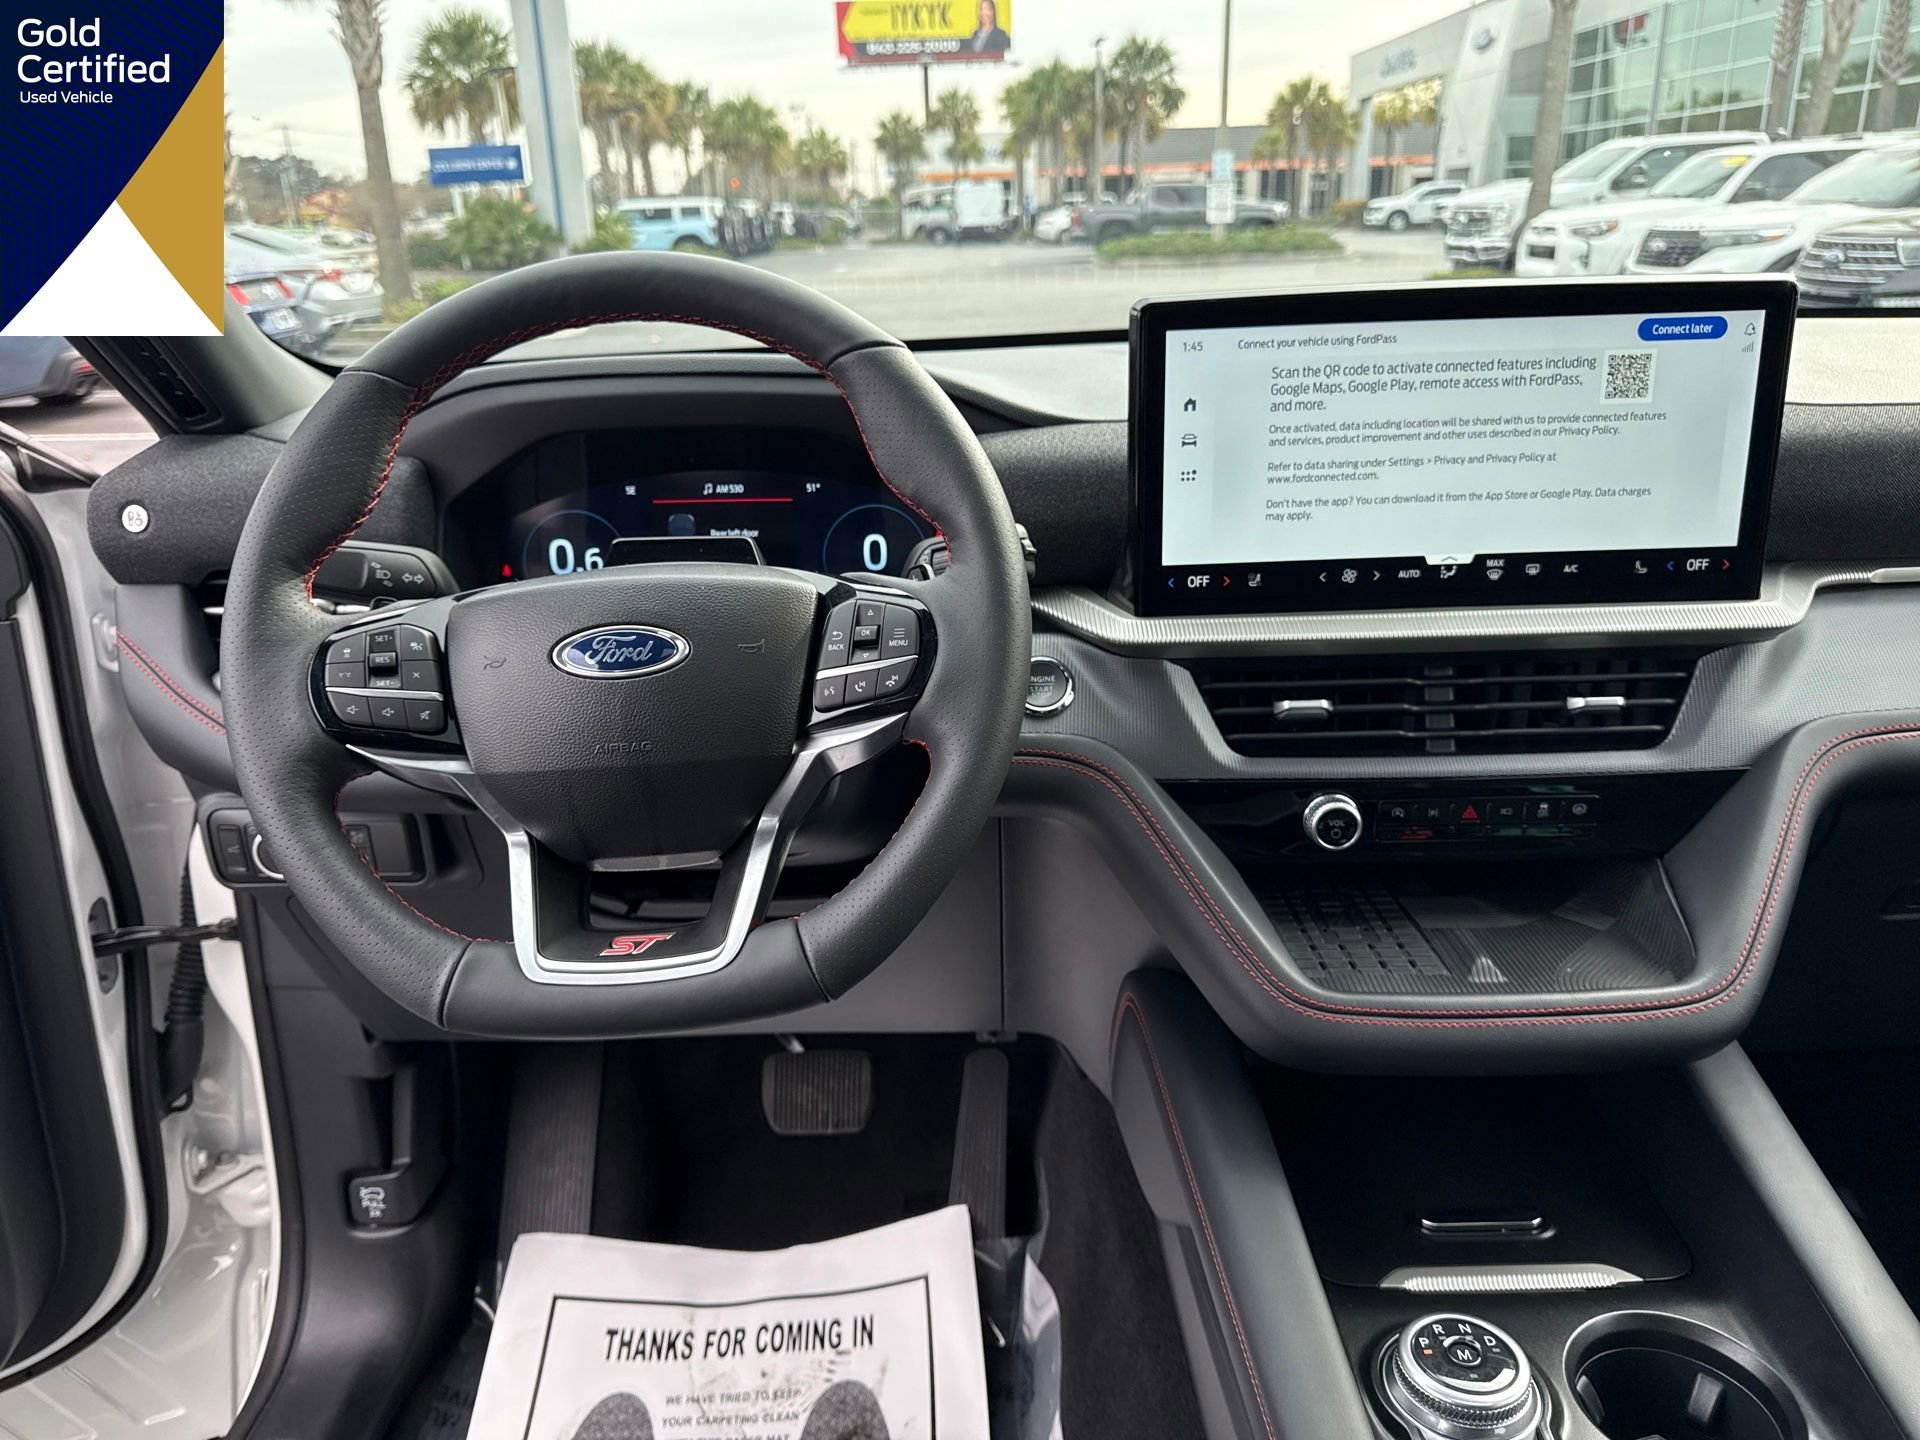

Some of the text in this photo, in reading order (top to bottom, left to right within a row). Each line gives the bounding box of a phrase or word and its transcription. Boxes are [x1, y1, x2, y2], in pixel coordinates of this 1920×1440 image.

[1652, 323, 1713, 336] Connect later
[1183, 342, 1204, 352] 1:45
[1237, 334, 1398, 349] Connect your vehicle using FordPass
[1271, 356, 1596, 379] Scan the QR code to activate connected features including
[1270, 373, 1582, 397] Google Maps, Google Play, remote access with FordPass,
[1269, 399, 1326, 412] and more.
[1268, 424, 1292, 434] Once
[1293, 421, 1337, 433] activated,
[1339, 421, 1360, 431] data
[1362, 419, 1402, 430] including
[1403, 418, 1440, 428] location
[1441, 417, 1456, 427] will
[1458, 417, 1470, 426] be
[1471, 416, 1502, 426] shared
[1504, 415, 1523, 424] with
[1536, 415, 1546, 424] to
[1547, 413, 1580, 427] provide
[1582, 411, 1628, 422] connected
[1630, 411, 1666, 421] features
[1268, 425, 1620, 446] and services, product improvement and other uses described in our Privacy Policy.
[1267, 461, 1291, 471] Refer
[1293, 462, 1302, 470] to
[1304, 460, 1325, 470] data
[1327, 459, 1359, 470] sharing
[1360, 458, 1387, 468] under
[1387, 456, 1424, 467] Settings
[1434, 455, 1466, 466] Privacy
[1466, 454, 1484, 464] and
[1486, 453, 1517, 464] Privacy
[1518, 452, 1545, 463] Policy
[1546, 452, 1557, 461] at
[1266, 471, 1379, 484] www.fordconnected.com.
[806, 482, 821, 493] 51°
[1266, 499, 1290, 509] Don't
[1291, 498, 1312, 507] have
[1314, 497, 1329, 506] the
[1330, 496, 1354, 507] app?
[1355, 496, 1372, 505] You
[1374, 496, 1390, 504] can
[1391, 493, 1436, 504] download
[1436, 493, 1444, 502] it
[1445, 492, 1466, 501] from
[1468, 492, 1483, 501] the
[1484, 491, 1503, 501] App
[1504, 490, 1528, 500] Store
[1540, 488, 1570, 500] Google
[1572, 488, 1593, 499] Play.
[1594, 487, 1616, 497] Data
[1617, 487, 1651, 497] charges
[1265, 510, 1312, 522] may apply.
[862, 533, 888, 571] 0
[1486, 558, 1504, 568] MAX
[1563, 564, 1580, 574] A/C
[1686, 558, 1710, 572] OFF
[1398, 569, 1420, 578] AUTO
[1187, 576, 1210, 588] OFF
[583, 634, 654, 664] Ford
[1030, 674, 1056, 682] NGINE
[594, 741, 652, 754] AIRBAG
[597, 932, 676, 956] ST
[604, 1314, 875, 1362] THANKS FOR COMING IN
[1418, 1323, 1496, 1348] P R N D
[1456, 1350, 1473, 1361] M
[666, 1394, 682, 1405] WE
[686, 1392, 717, 1404] HAVE
[720, 1392, 750, 1404] TRIED
[755, 1390, 770, 1400] TO
[662, 1410, 800, 1428] YOUR CARPETING CLEAN
